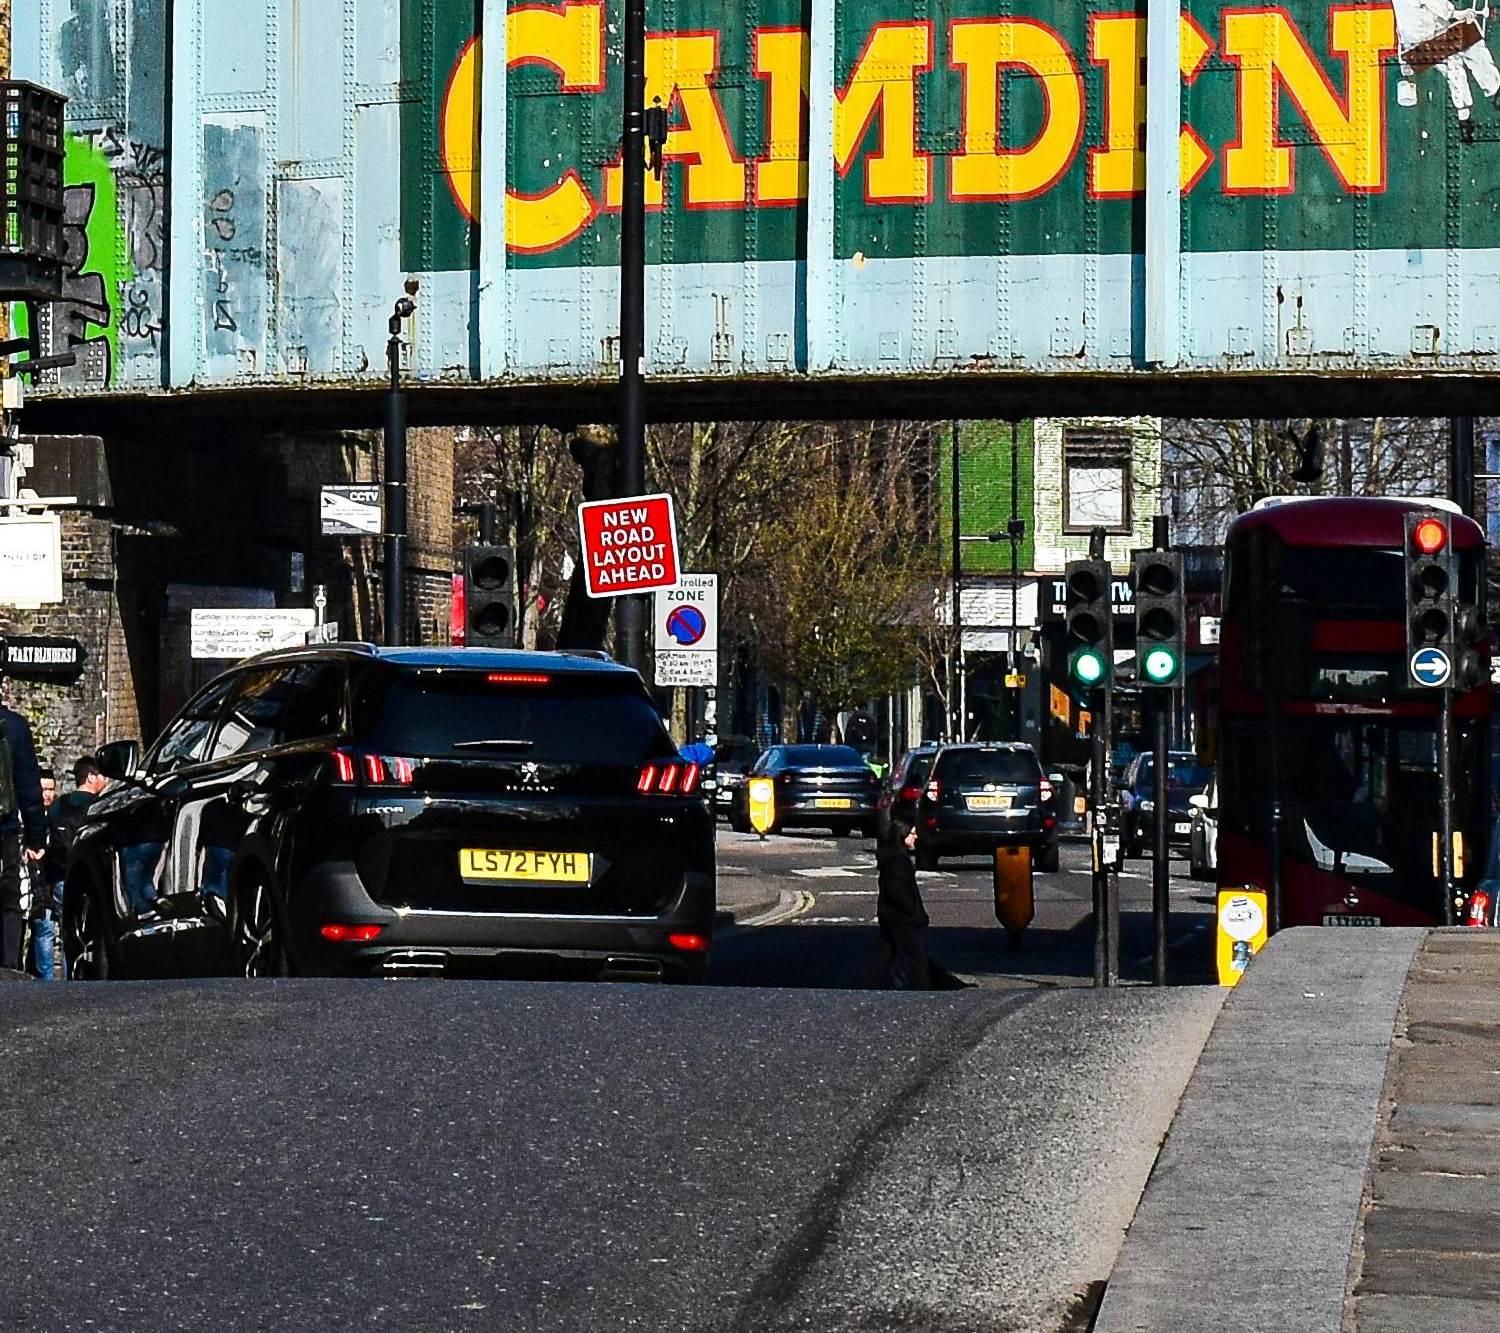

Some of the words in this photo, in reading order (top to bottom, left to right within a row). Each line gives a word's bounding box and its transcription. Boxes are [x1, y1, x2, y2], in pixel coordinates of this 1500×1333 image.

[349, 491, 379, 502] CCTV
[603, 507, 648, 528] NEW
[600, 526, 655, 547] ROAD
[593, 543, 666, 567] LAYOUT
[598, 563, 665, 585] AHEAD
[679, 578, 714, 588] trolled
[666, 590, 705, 602] ZONE
[470, 850, 528, 873] LS72
[534, 851, 576, 875] FYH
